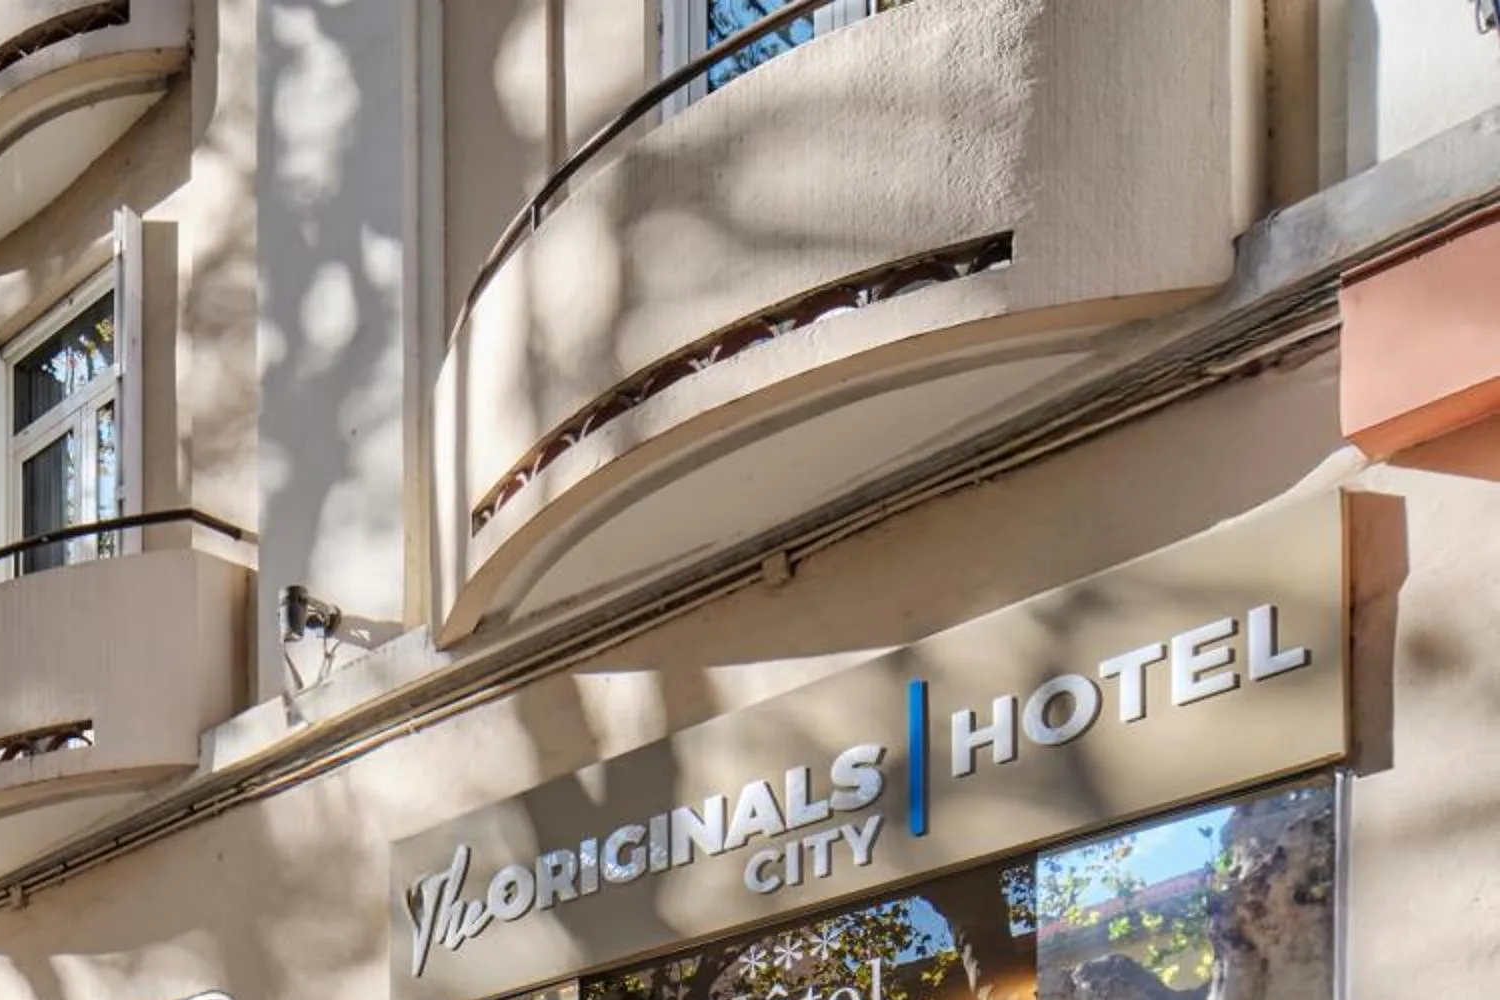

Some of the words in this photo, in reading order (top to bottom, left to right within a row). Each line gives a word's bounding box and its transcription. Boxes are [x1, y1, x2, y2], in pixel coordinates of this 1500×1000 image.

[951, 603, 1311, 778] HOTEL
[403, 844, 494, 977] The
[487, 743, 886, 922] ORIGINALS
[744, 815, 884, 894] CITY
